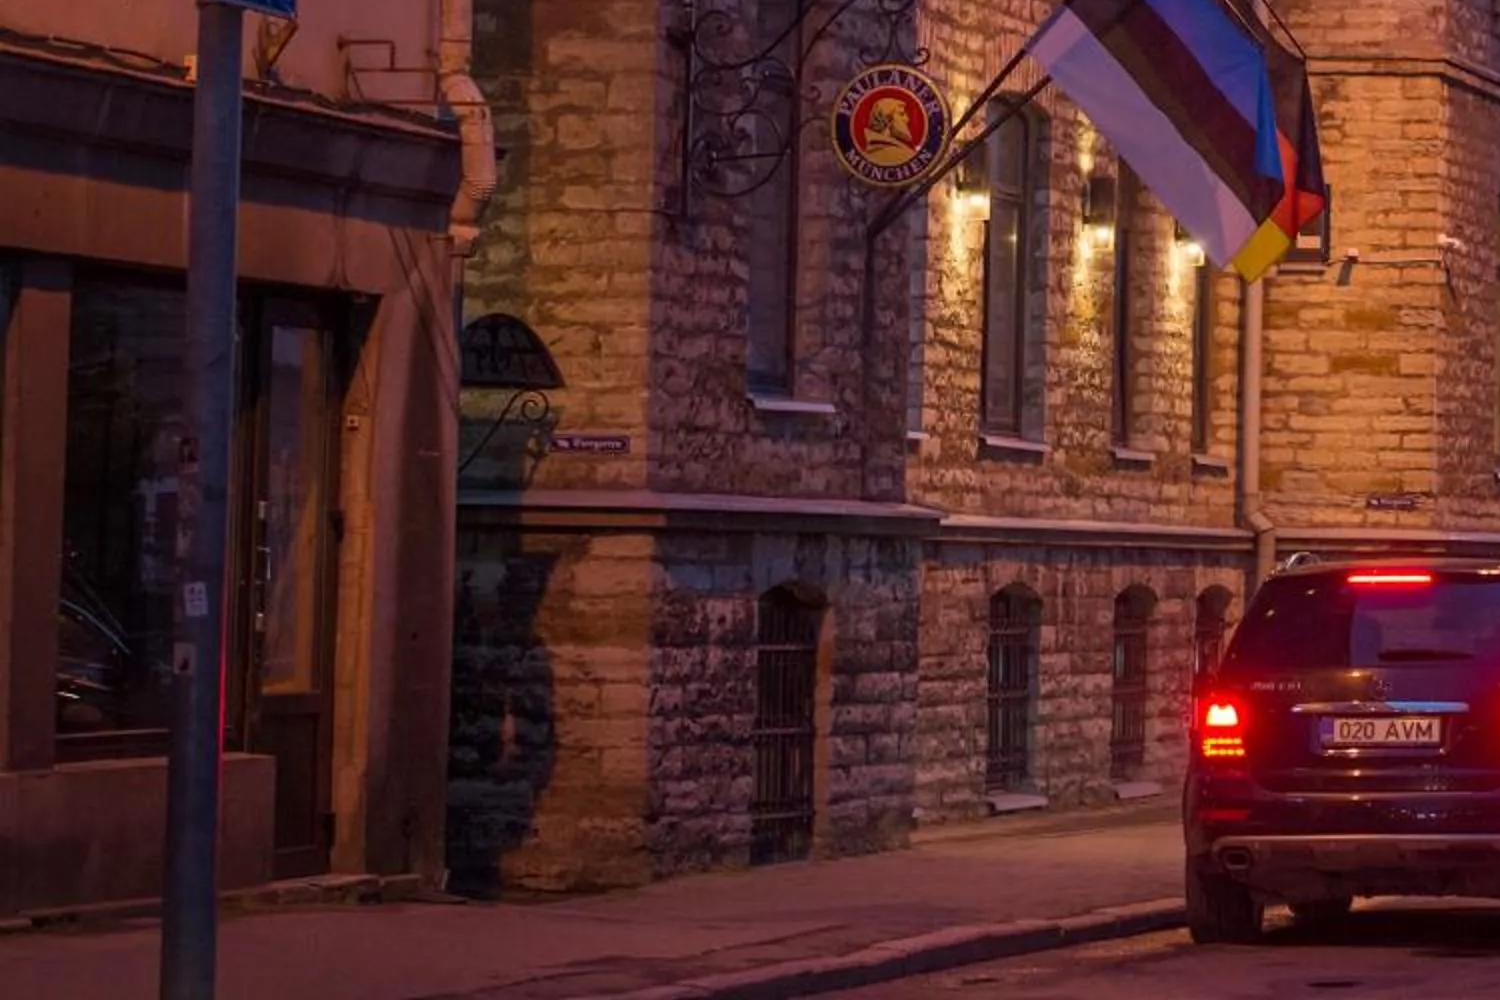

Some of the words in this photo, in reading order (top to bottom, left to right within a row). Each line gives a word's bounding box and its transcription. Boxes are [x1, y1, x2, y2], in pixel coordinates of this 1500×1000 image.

[839, 70, 940, 115] PAULANER
[1340, 721, 1375, 739] 020
[1385, 721, 1433, 739] AVM
